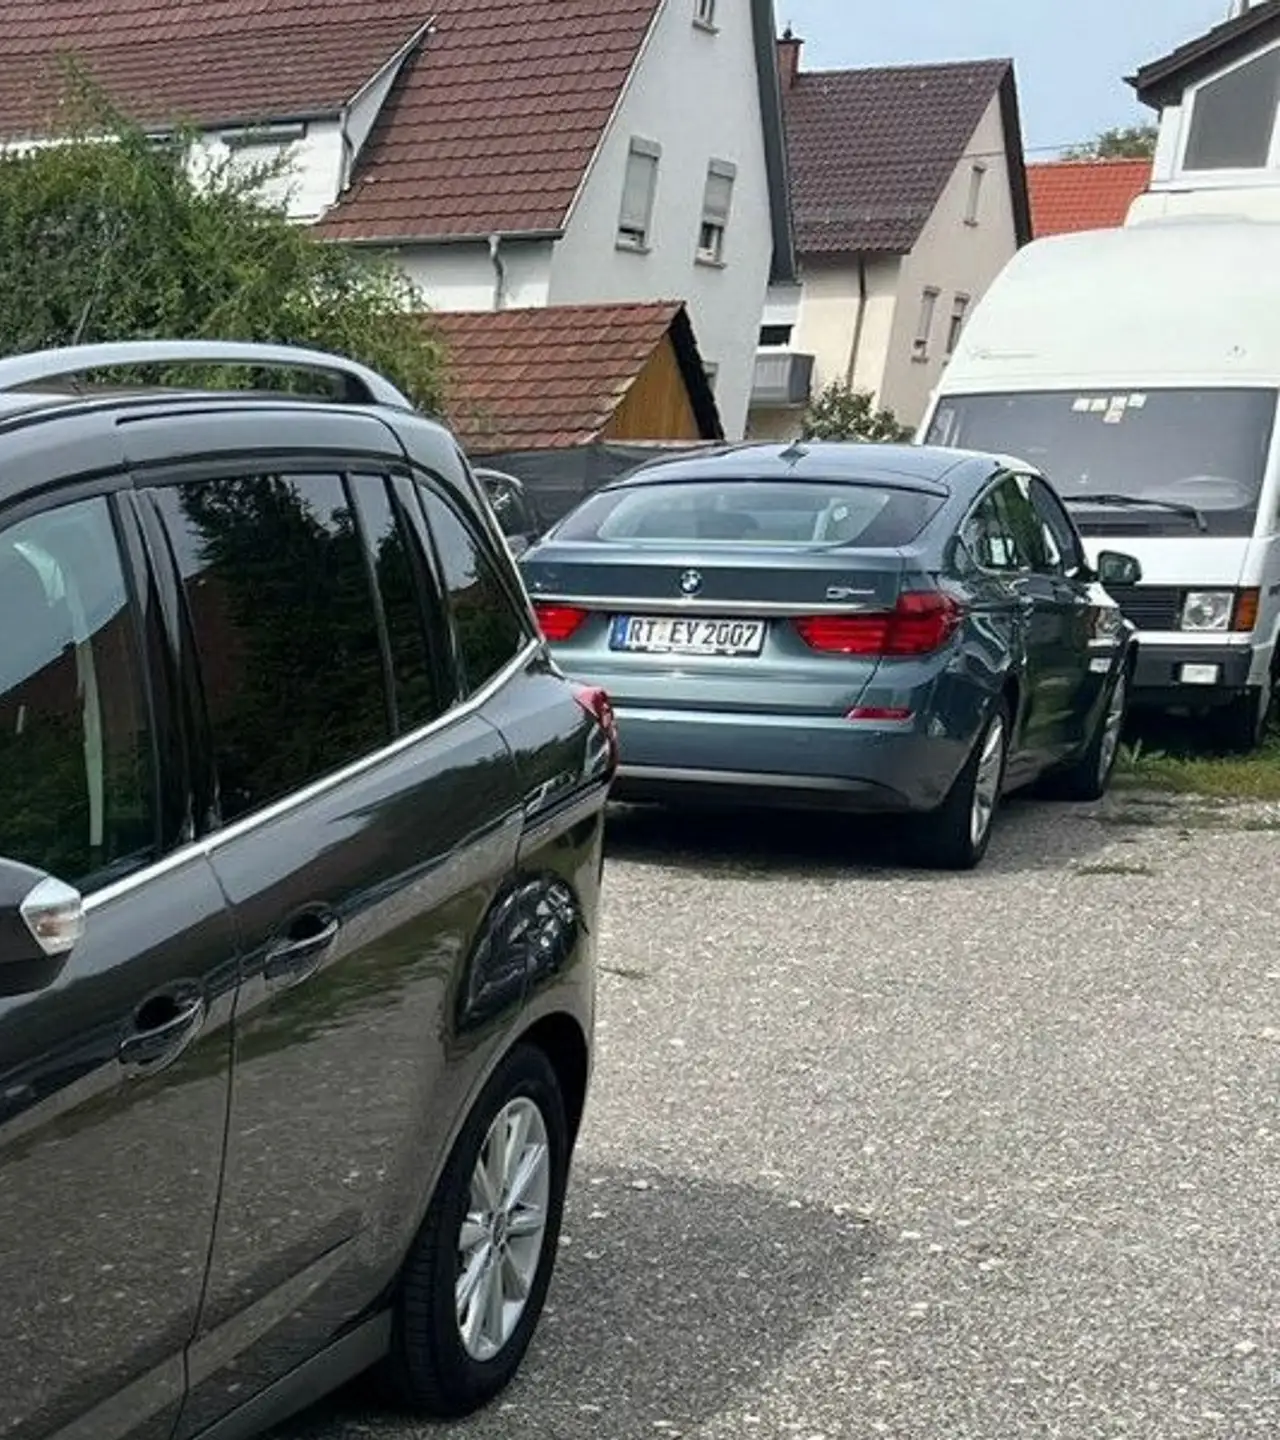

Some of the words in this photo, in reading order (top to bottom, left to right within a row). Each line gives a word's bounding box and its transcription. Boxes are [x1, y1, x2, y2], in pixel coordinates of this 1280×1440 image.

[629, 619, 657, 643] RT
[669, 621, 699, 645] EY
[702, 622, 759, 648] 2007
